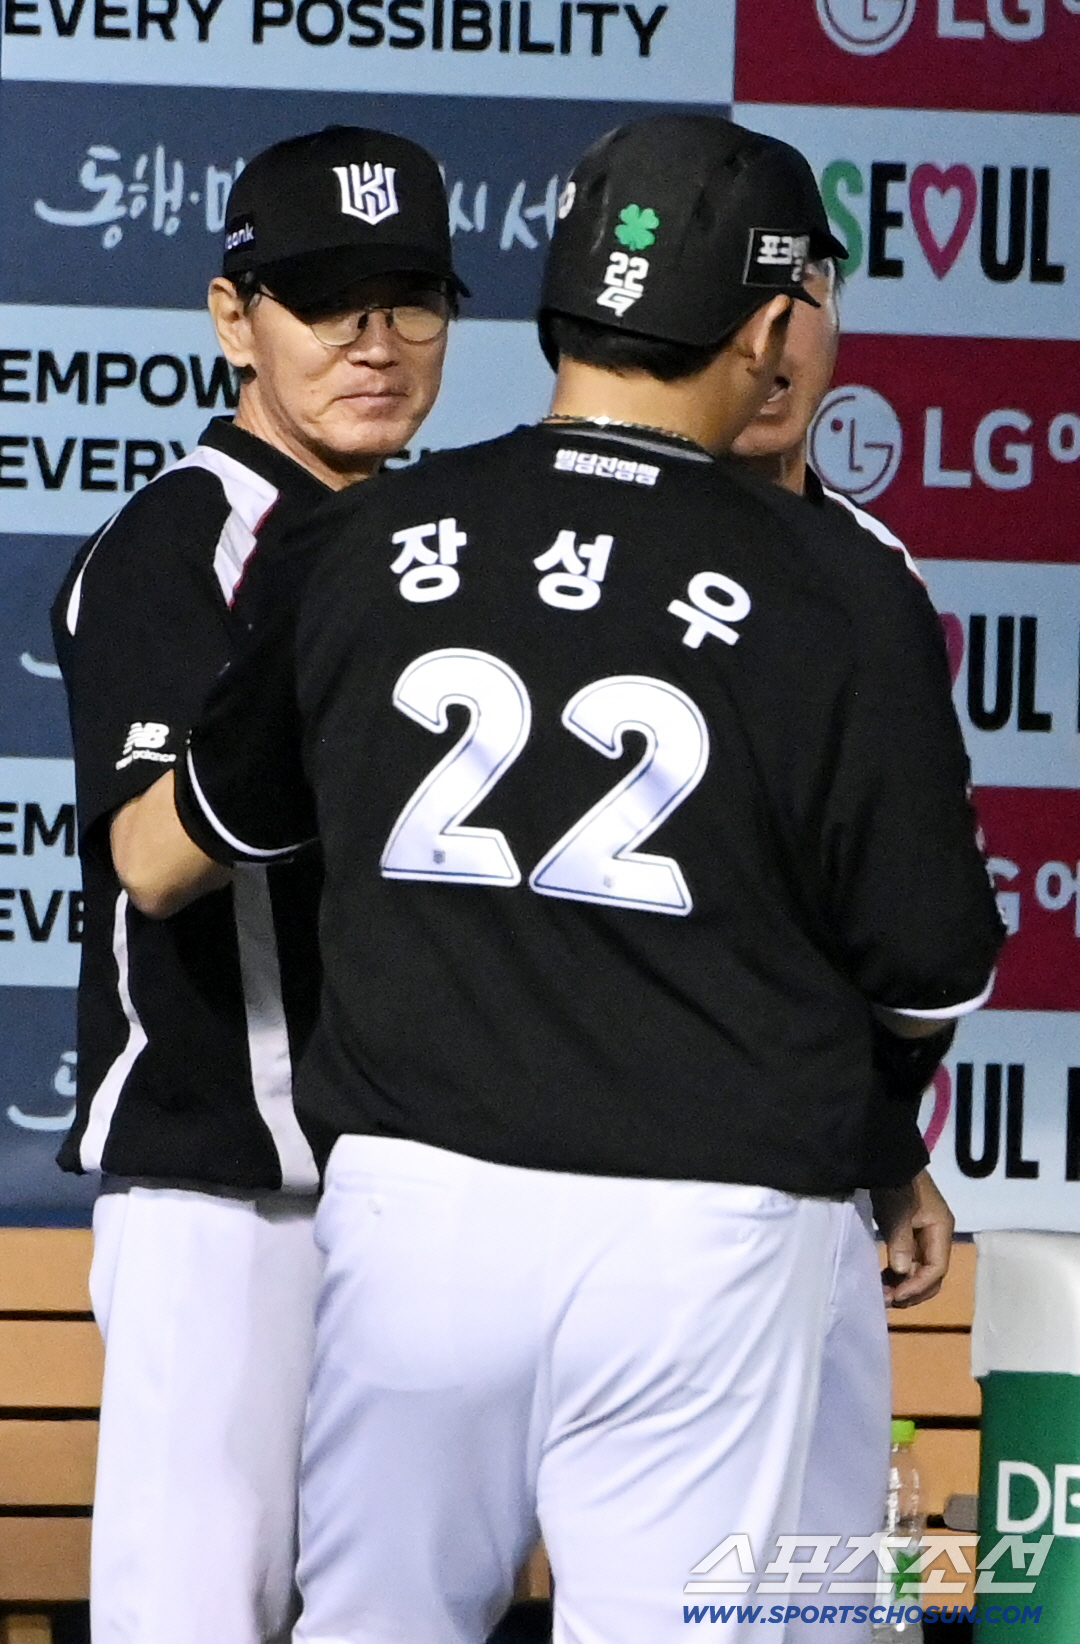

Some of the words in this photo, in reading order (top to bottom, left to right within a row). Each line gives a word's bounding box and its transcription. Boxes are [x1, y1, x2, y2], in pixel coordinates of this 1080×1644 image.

[3, 0, 218, 42] EVERY
[252, 0, 667, 57] POSSIBILITY
[604, 252, 649, 293] 22
[390, 518, 751, 649] 장성우
[380, 647, 710, 917] 22
